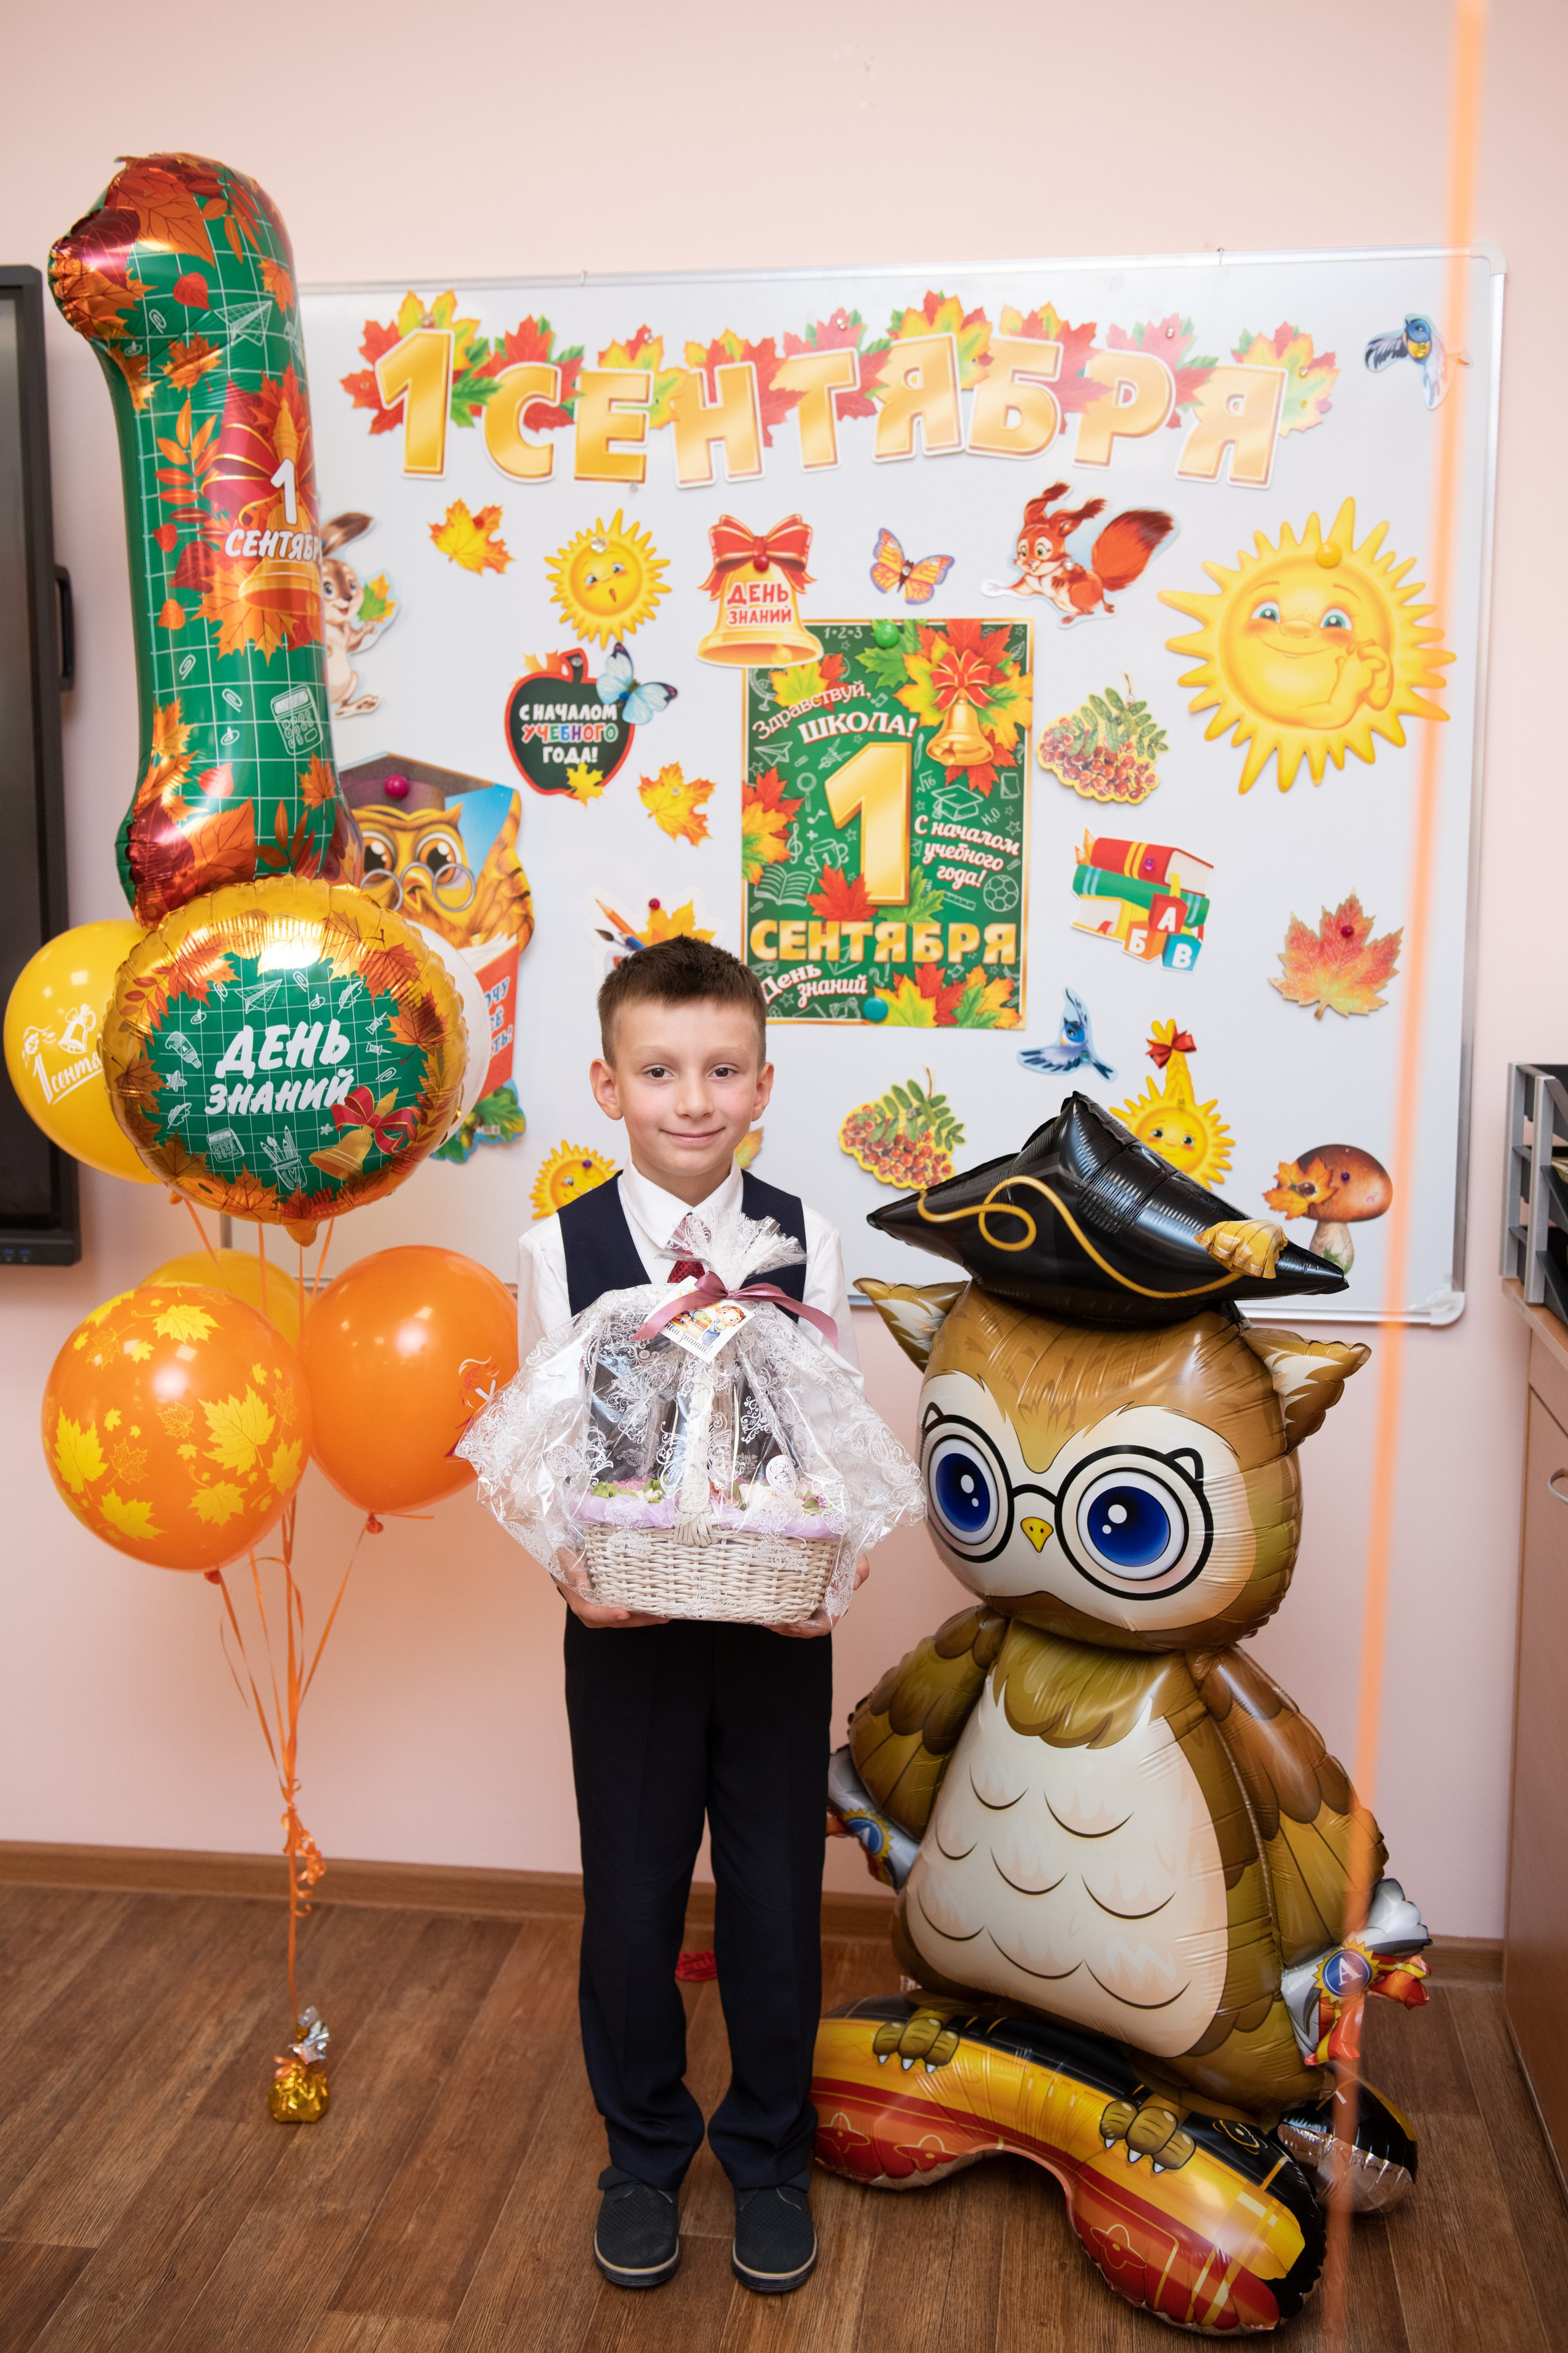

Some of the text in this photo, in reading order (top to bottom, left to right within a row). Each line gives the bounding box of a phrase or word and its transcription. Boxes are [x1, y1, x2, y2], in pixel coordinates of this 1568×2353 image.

[375, 330, 1287, 489] 1 СЕНТЯБРЯ
[270, 458, 298, 524] 1
[224, 528, 323, 565] СЕНТЯБР
[726, 582, 790, 606] ДЕНЬ
[728, 605, 791, 625] ЗНАНИЙ
[519, 704, 617, 722] С НАЧАЛОМ
[752, 680, 872, 740] Здравствуй,
[797, 712, 918, 744] ШКОЛА!
[522, 723, 619, 742] УЧЕБНОГО
[543, 746, 598, 764] ГОДА!
[824, 742, 913, 905] 1
[914, 815, 1020, 856] С началом
[922, 842, 1005, 872] учебного
[936, 863, 987, 891] года!
[750, 920, 1017, 965] СЕНТЯБРЯ
[1128, 928, 1148, 954] Б
[761, 964, 823, 1005] День
[797, 974, 868, 1009] знаний
[214, 1019, 351, 1079] ДЕНЬ
[32, 1051, 102, 1105] 1 сентя
[204, 1068, 354, 1115] ЗНАНИЙ
